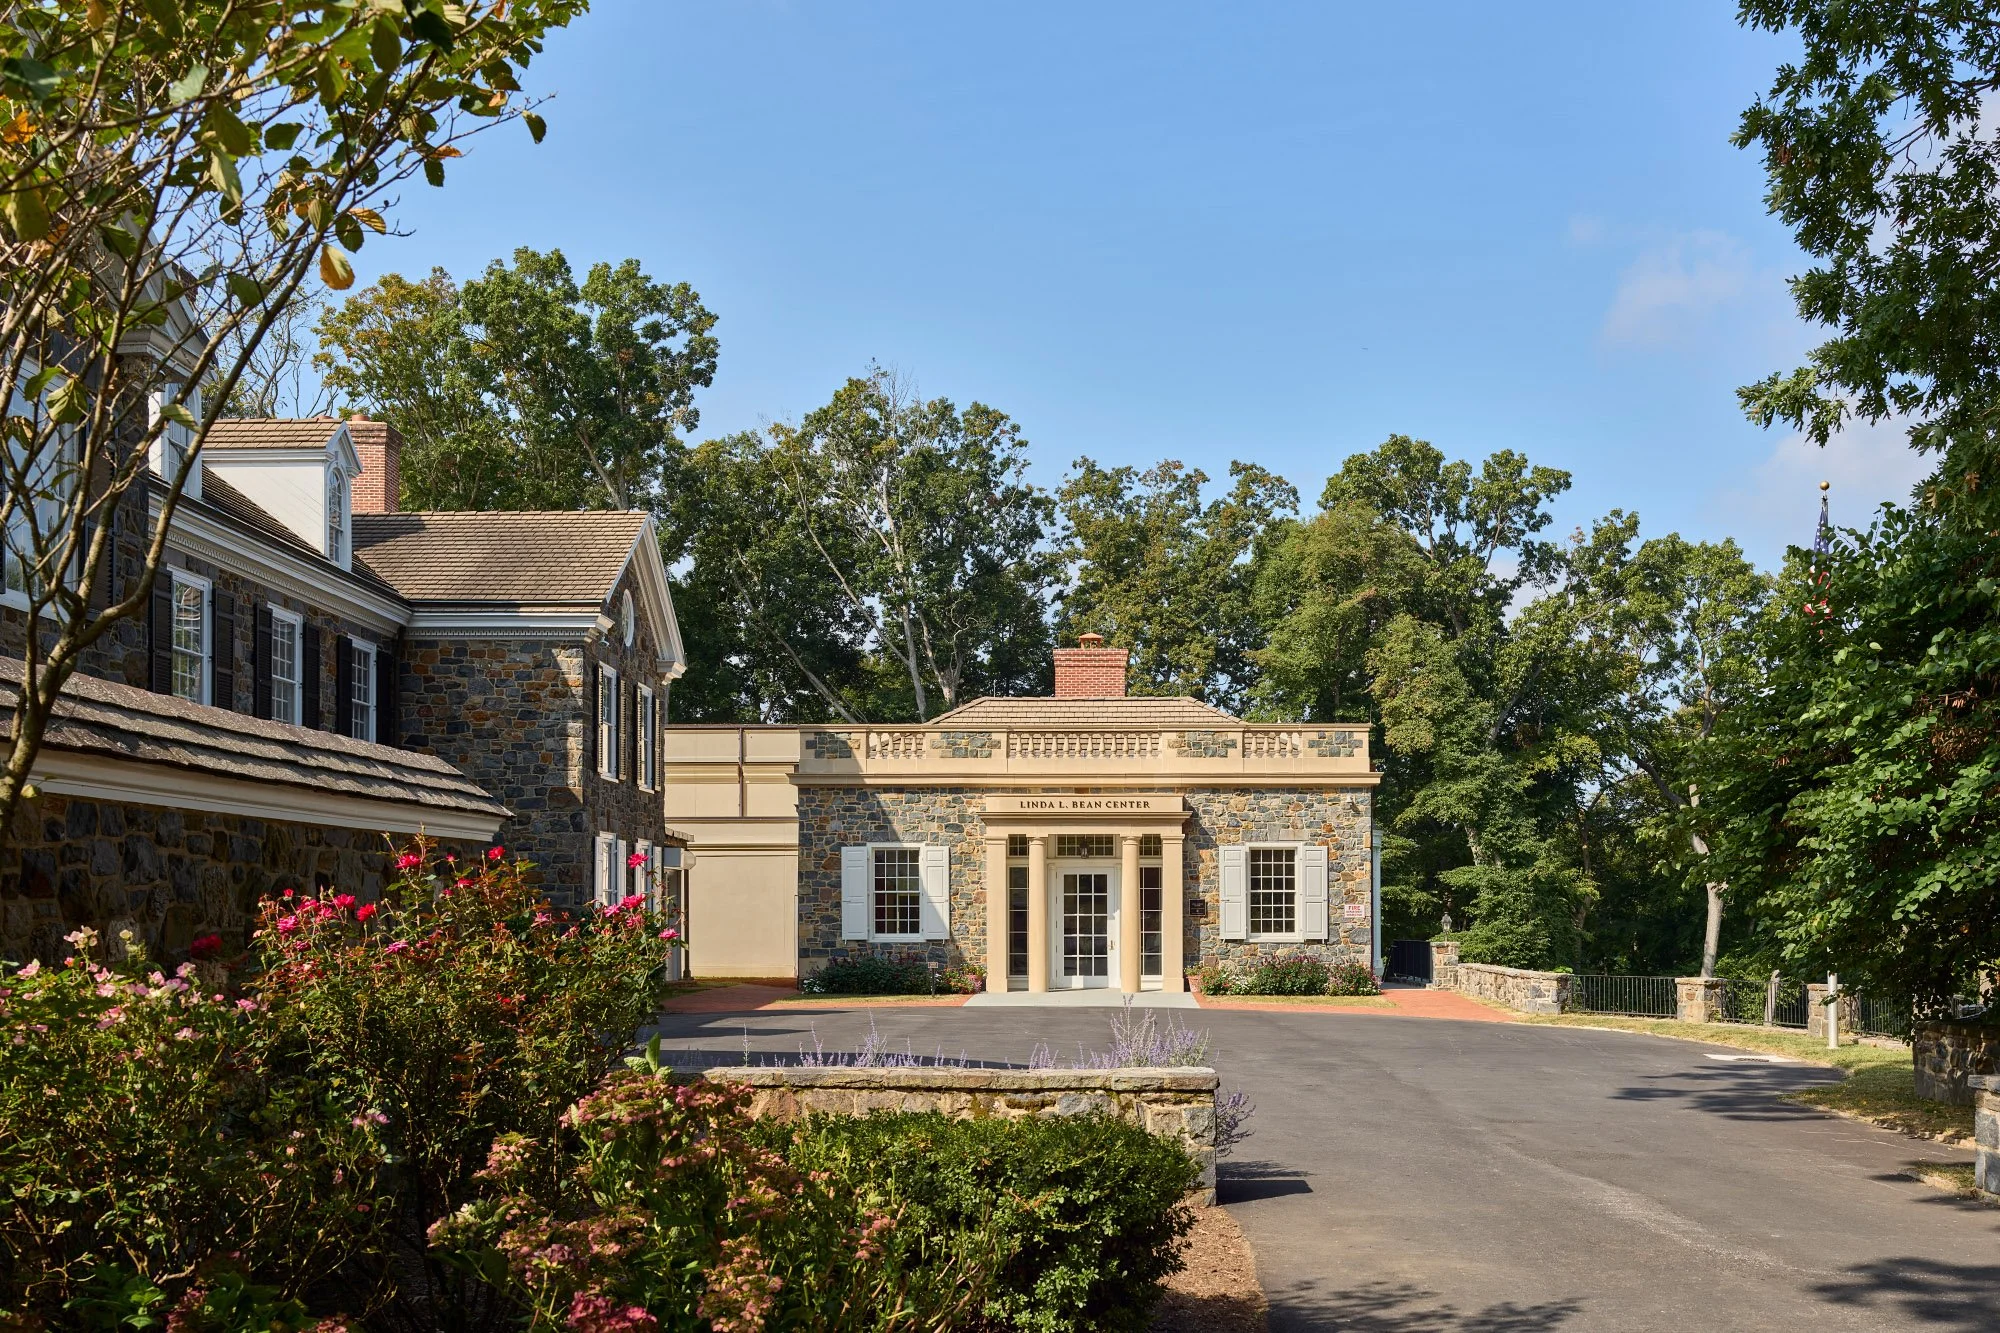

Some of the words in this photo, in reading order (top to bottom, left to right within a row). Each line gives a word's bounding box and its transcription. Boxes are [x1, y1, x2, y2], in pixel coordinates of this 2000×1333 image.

[1020, 800, 1055, 809] LINDA
[1059, 800, 1068, 809] L.
[1072, 800, 1102, 809] BEAN
[1105, 800, 1150, 809] CENTER
